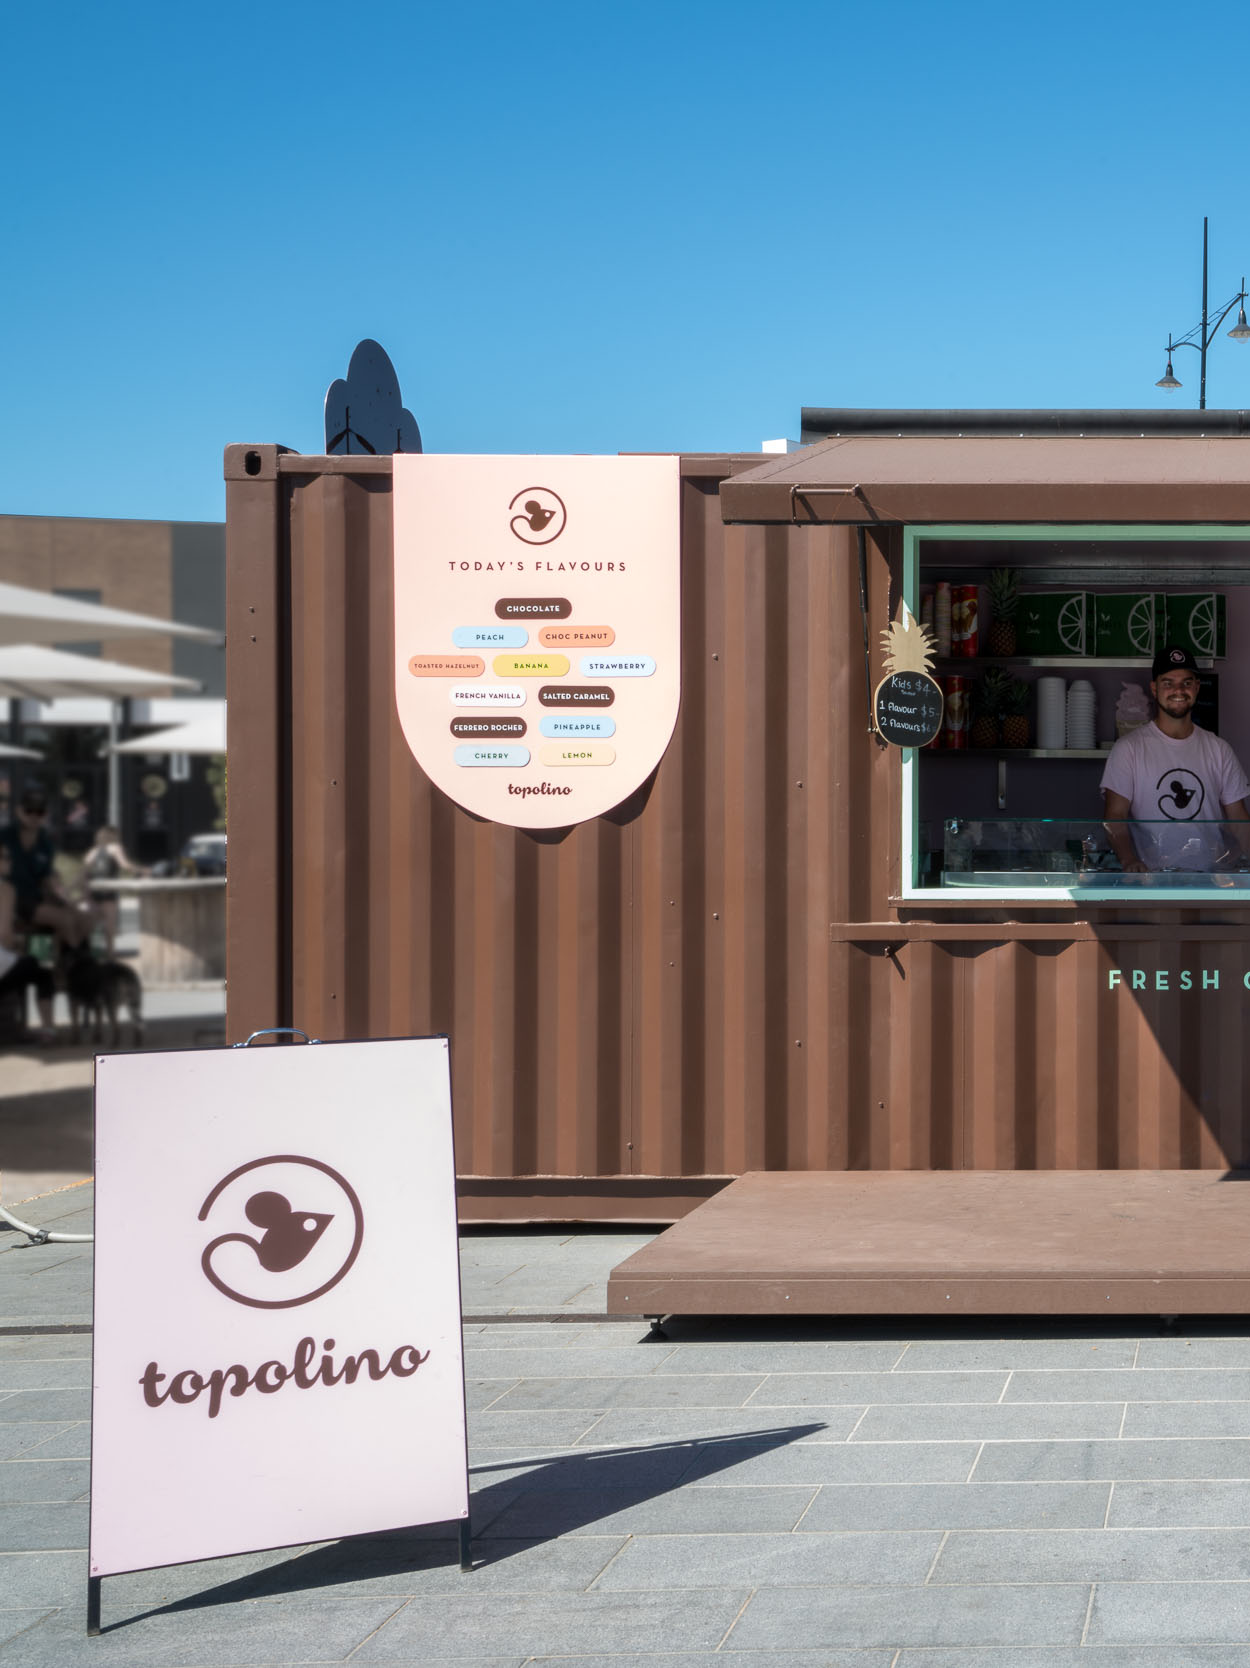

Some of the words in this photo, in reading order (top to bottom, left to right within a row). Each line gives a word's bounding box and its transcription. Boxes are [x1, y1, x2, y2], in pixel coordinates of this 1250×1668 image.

[448, 561, 525, 571] TODAY'S
[536, 561, 627, 572] FLAVOURS
[506, 605, 560, 613] CHOCOLATE
[891, 676, 911, 689] Kids
[543, 692, 572, 700] SALTED
[573, 692, 610, 700] CARAMEL
[879, 700, 886, 710] 1
[881, 716, 887, 726] 2
[507, 782, 573, 799] topolino
[1108, 969, 1221, 990] FRESH
[138, 1336, 430, 1419] topolino
